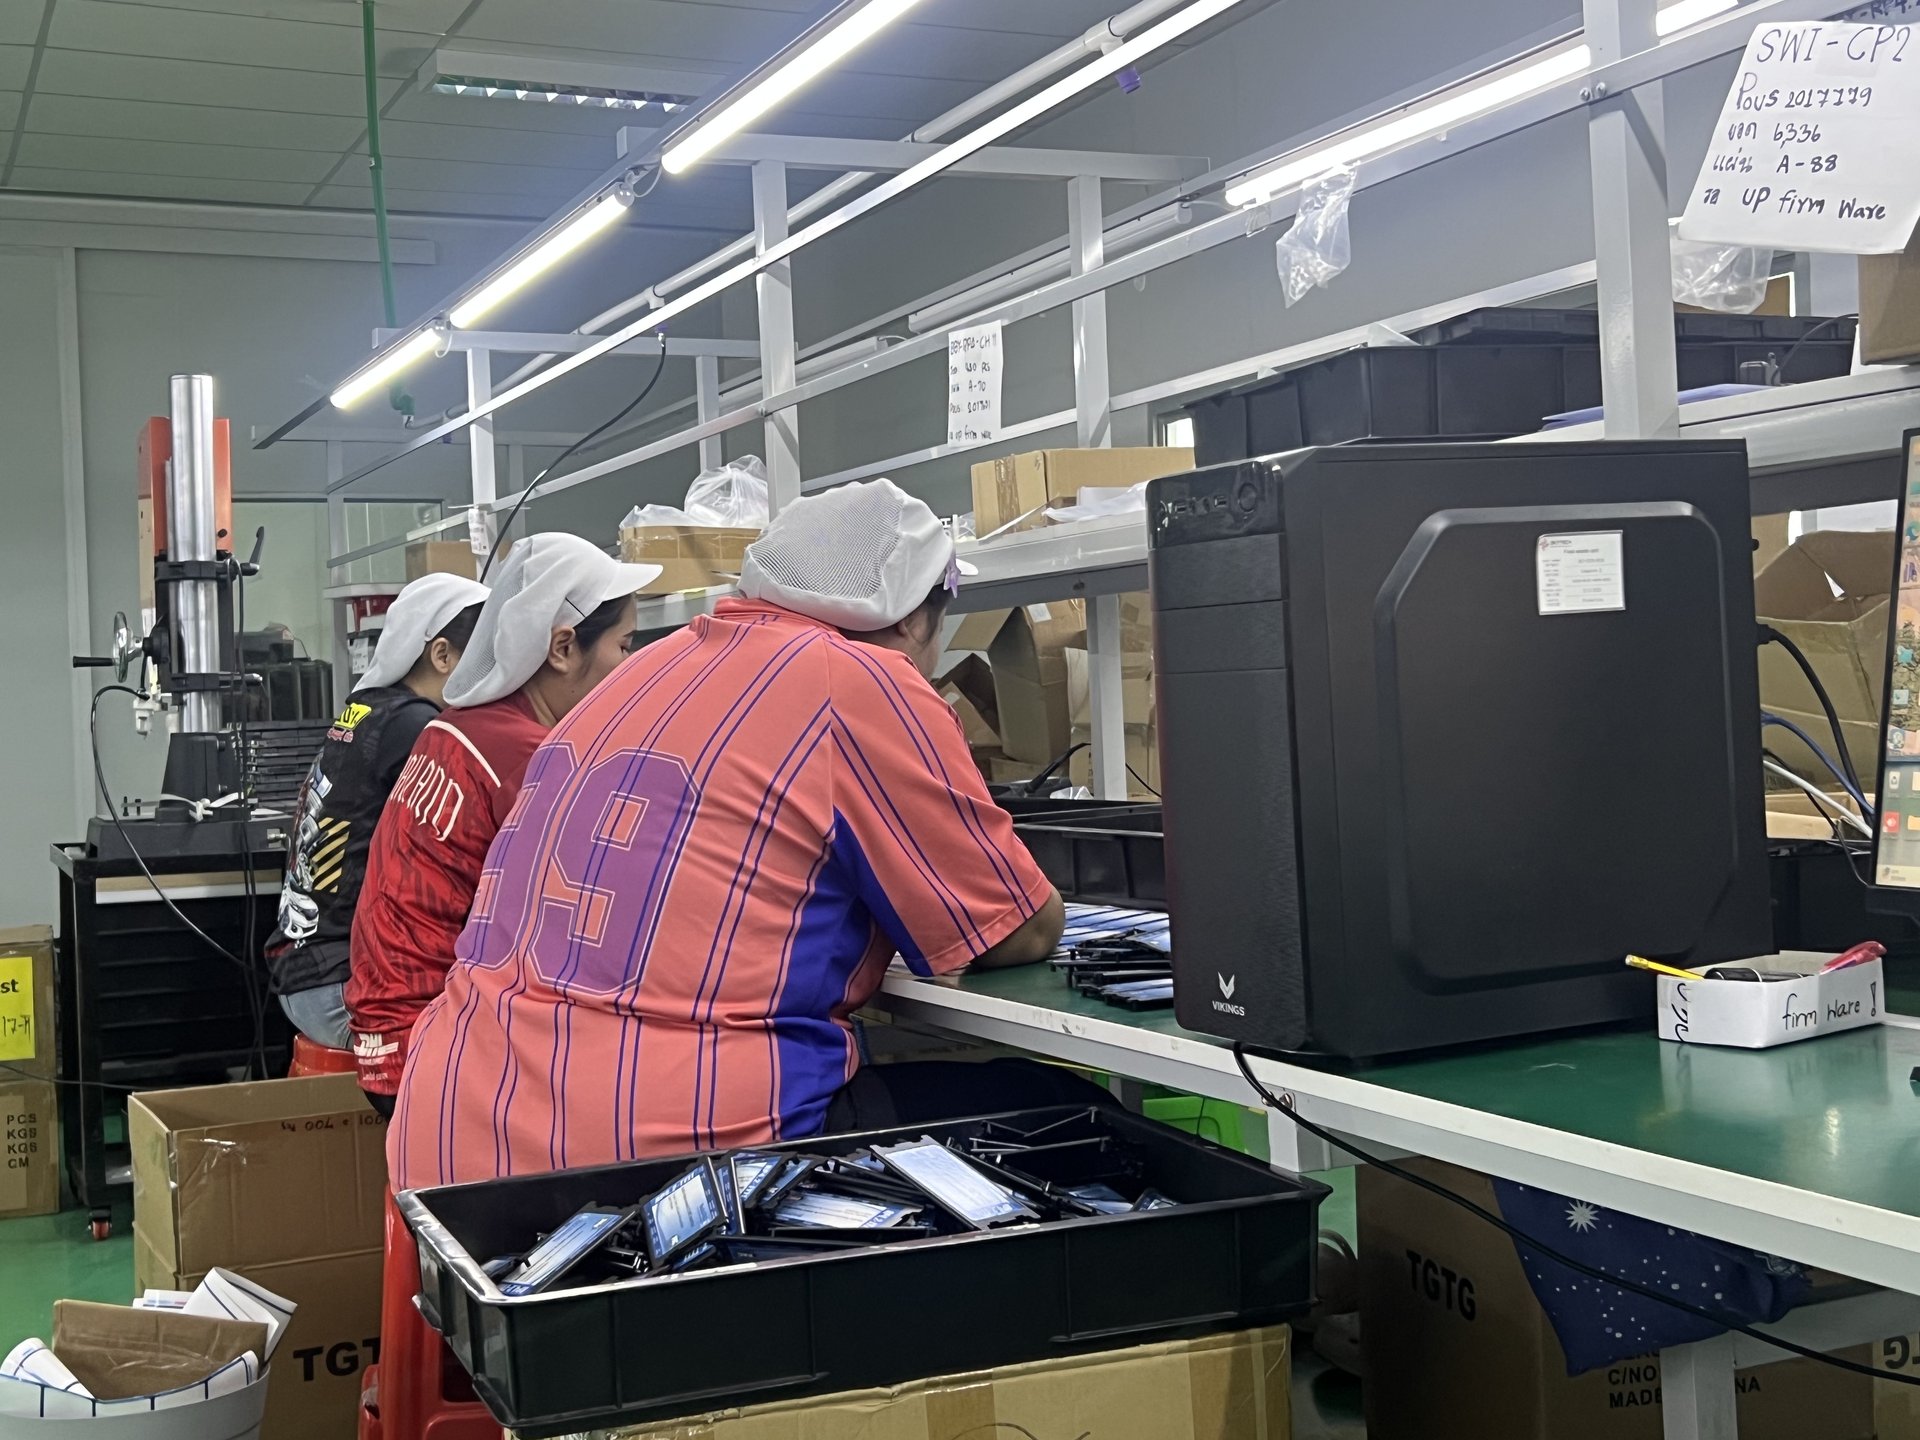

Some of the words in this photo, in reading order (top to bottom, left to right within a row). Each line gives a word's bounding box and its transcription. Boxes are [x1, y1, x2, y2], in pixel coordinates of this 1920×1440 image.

[1212, 1000, 1245, 1016] VIKINGS
[1782, 993, 1817, 1030] firm
[7, 1113, 37, 1125] PCS
[7, 1128, 37, 1140] KGS
[7, 1142, 38, 1155] KGS
[1405, 1250, 1477, 1321] TGTG
[1609, 1387, 1663, 1409] MADE
